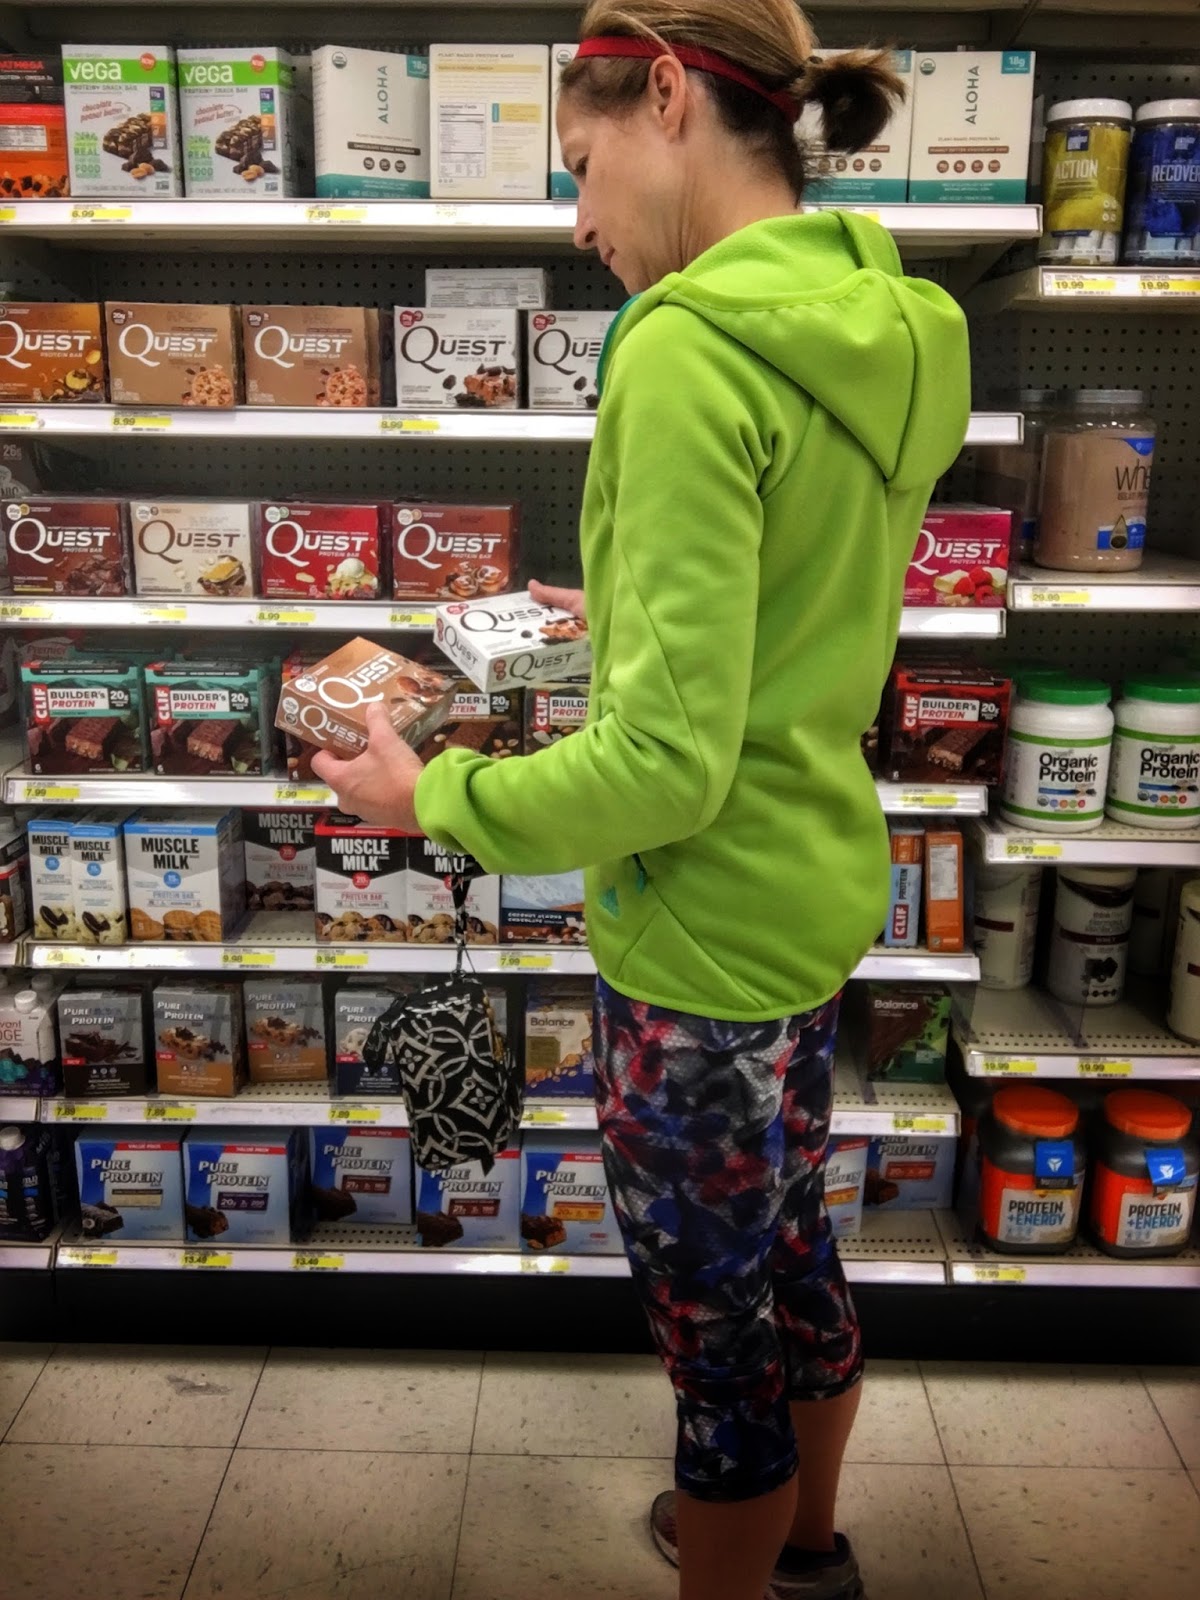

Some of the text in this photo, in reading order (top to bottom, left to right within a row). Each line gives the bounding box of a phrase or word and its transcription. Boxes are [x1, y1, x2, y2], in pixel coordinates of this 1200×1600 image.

[378, 65, 388, 124] ALOHA
[966, 66, 979, 125] ALOHA
[1055, 160, 1098, 179] ACTION
[119, 324, 212, 367] QUEST
[255, 325, 350, 369] QUEST
[401, 326, 506, 374] QUEST
[534, 329, 602, 375] QUE
[9, 518, 111, 564] QUEST
[138, 520, 240, 564] QUEST
[266, 521, 369, 567] QUEST
[398, 523, 501, 569] QUEST
[391, 614, 412, 622] 8.99
[460, 605, 555, 632] QUEST
[444, 626, 478, 664] QUEST
[510, 652, 576, 680] QUEST
[318, 654, 397, 709] QUEST
[50, 690, 106, 699] BUILDER's
[173, 693, 227, 701] BUILDER's
[35, 688, 47, 719] CLIF
[52, 700, 95, 708] PROTEIN
[158, 687, 170, 720] CLIF
[173, 702, 216, 710] PROTEIN
[536, 695, 548, 726] CLIF
[552, 700, 588, 708] BUILD
[922, 700, 976, 711] BUILDER's
[905, 696, 918, 727] CLIF
[922, 710, 965, 718] PROTEIN
[300, 705, 368, 748] QUEST
[1039, 752, 1098, 771] Organic
[1141, 748, 1199, 768] Organic
[1039, 767, 1095, 783] Protein
[1141, 763, 1198, 779] Protein
[26, 789, 47, 797] 7.99
[277, 791, 297, 799] 7.99
[258, 813, 314, 829] MUSCLE
[32, 835, 69, 845] MUSCLE
[270, 829, 304, 844] MILK
[40, 846, 63, 856] MILK
[74, 841, 110, 851] MUSCLE
[141, 838, 199, 853] MUSCLE
[331, 839, 389, 855] MUSCLE
[81, 852, 104, 861] MILK
[153, 854, 189, 869] MILK
[343, 855, 380, 871] MILK
[899, 868, 908, 900] PROTEIN
[341, 893, 367, 901] PROTEIN
[894, 908, 907, 935] CLIF
[501, 958, 520, 966] 7.99
[874, 1000, 918, 1009] Balance
[71, 1017, 114, 1025] PROTEIN
[164, 1012, 204, 1020] PROTEIN
[347, 1015, 376, 1023] PROTE
[530, 1018, 575, 1026] Balance
[324, 1145, 363, 1157] PURE
[91, 1159, 131, 1170] PURE
[198, 1161, 238, 1173] PURE
[331, 1159, 393, 1170] PROTEIN
[99, 1171, 163, 1183] PROTEIN
[206, 1175, 271, 1187] PROTEIN
[430, 1169, 471, 1180] PURE
[536, 1170, 576, 1183] PURE
[438, 1181, 502, 1193] PROTEIN
[544, 1184, 607, 1197] PROTEIN
[1009, 1200, 1063, 1213] PROTEIN
[1129, 1203, 1181, 1217] PROTEIN
[1008, 1213, 1065, 1226] +ENERGY
[1127, 1215, 1182, 1229] +ENERGY
